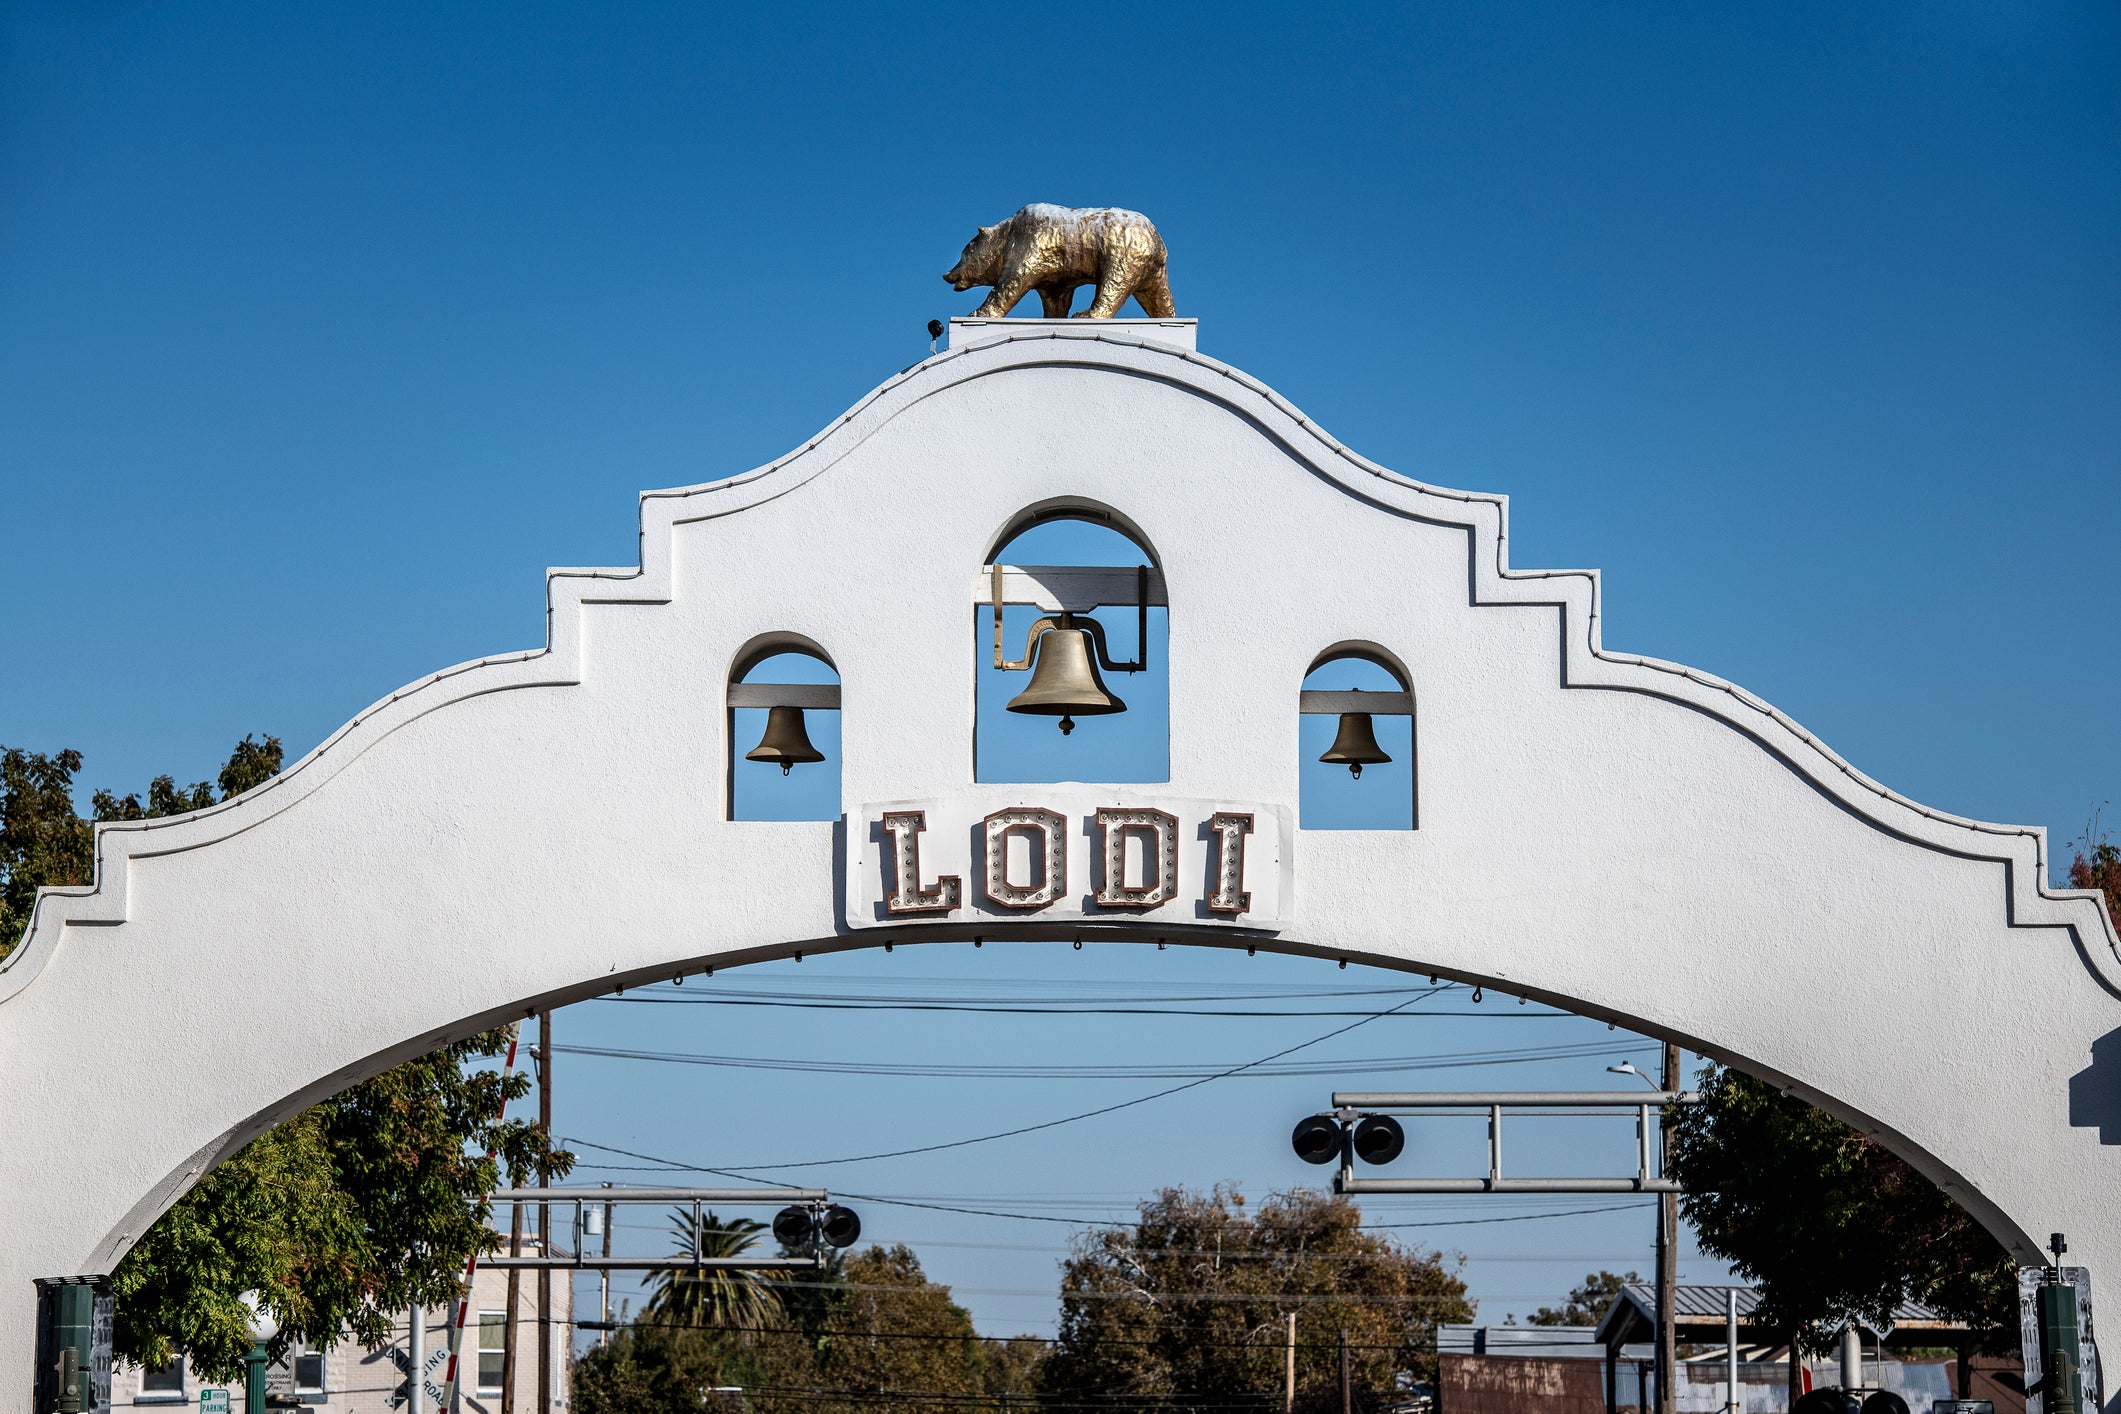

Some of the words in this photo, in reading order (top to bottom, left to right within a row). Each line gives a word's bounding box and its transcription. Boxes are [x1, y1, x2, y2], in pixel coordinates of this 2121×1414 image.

[882, 807, 1254, 914] LODI
[203, 1391, 209, 1400] 3
[202, 1404, 226, 1412] PARKING
